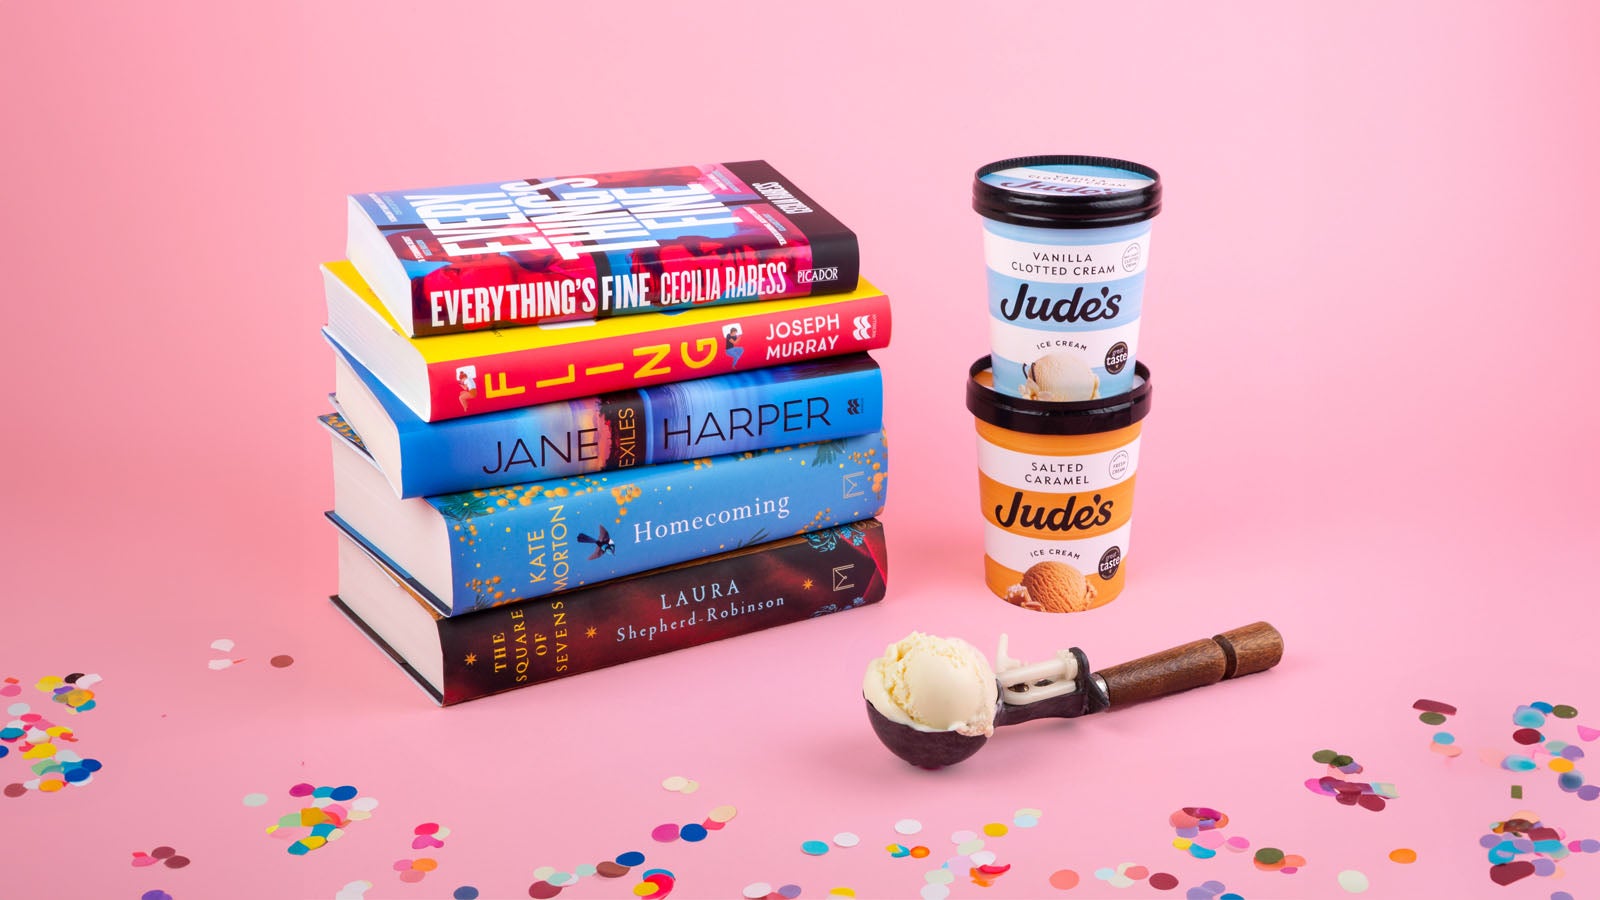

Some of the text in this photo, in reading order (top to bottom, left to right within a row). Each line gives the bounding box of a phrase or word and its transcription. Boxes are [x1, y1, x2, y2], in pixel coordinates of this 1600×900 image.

[403, 191, 552, 257] EVERY
[499, 177, 660, 260] THING'S
[610, 183, 744, 230] FINE
[1011, 261, 1068, 276] CLOTTED
[1073, 264, 1115, 276] CREAM
[1033, 251, 1093, 263] VANILLA
[430, 261, 839, 328] EVERYTHING'S FINE CECILIA RABESS PICADOR
[1000, 283, 1122, 323] Jude's
[766, 313, 840, 341] JOSEPH
[1036, 340, 1088, 351] ICE CREAM
[766, 335, 839, 361] MURRAY
[1106, 353, 1127, 366] taste
[482, 396, 832, 475] JANE HARPER
[618, 407, 635, 467] EXILES
[1024, 474, 1089, 486] CARAMEL
[1031, 462, 1084, 473] SALTED
[634, 496, 790, 543] Homecoming
[995, 491, 1114, 531] Jude's
[527, 529, 547, 584] KATE
[548, 505, 569, 592] MORTON
[1030, 548, 1081, 560] ICE CREAM
[1100, 556, 1120, 572] taste
[660, 579, 740, 611] LAURA
[552, 600, 569, 672] SEVENS
[616, 596, 785, 642] Shepherd-Robinson
[492, 632, 507, 673] THE
[511, 609, 530, 682] SQUARE
[534, 633, 548, 656] OF
